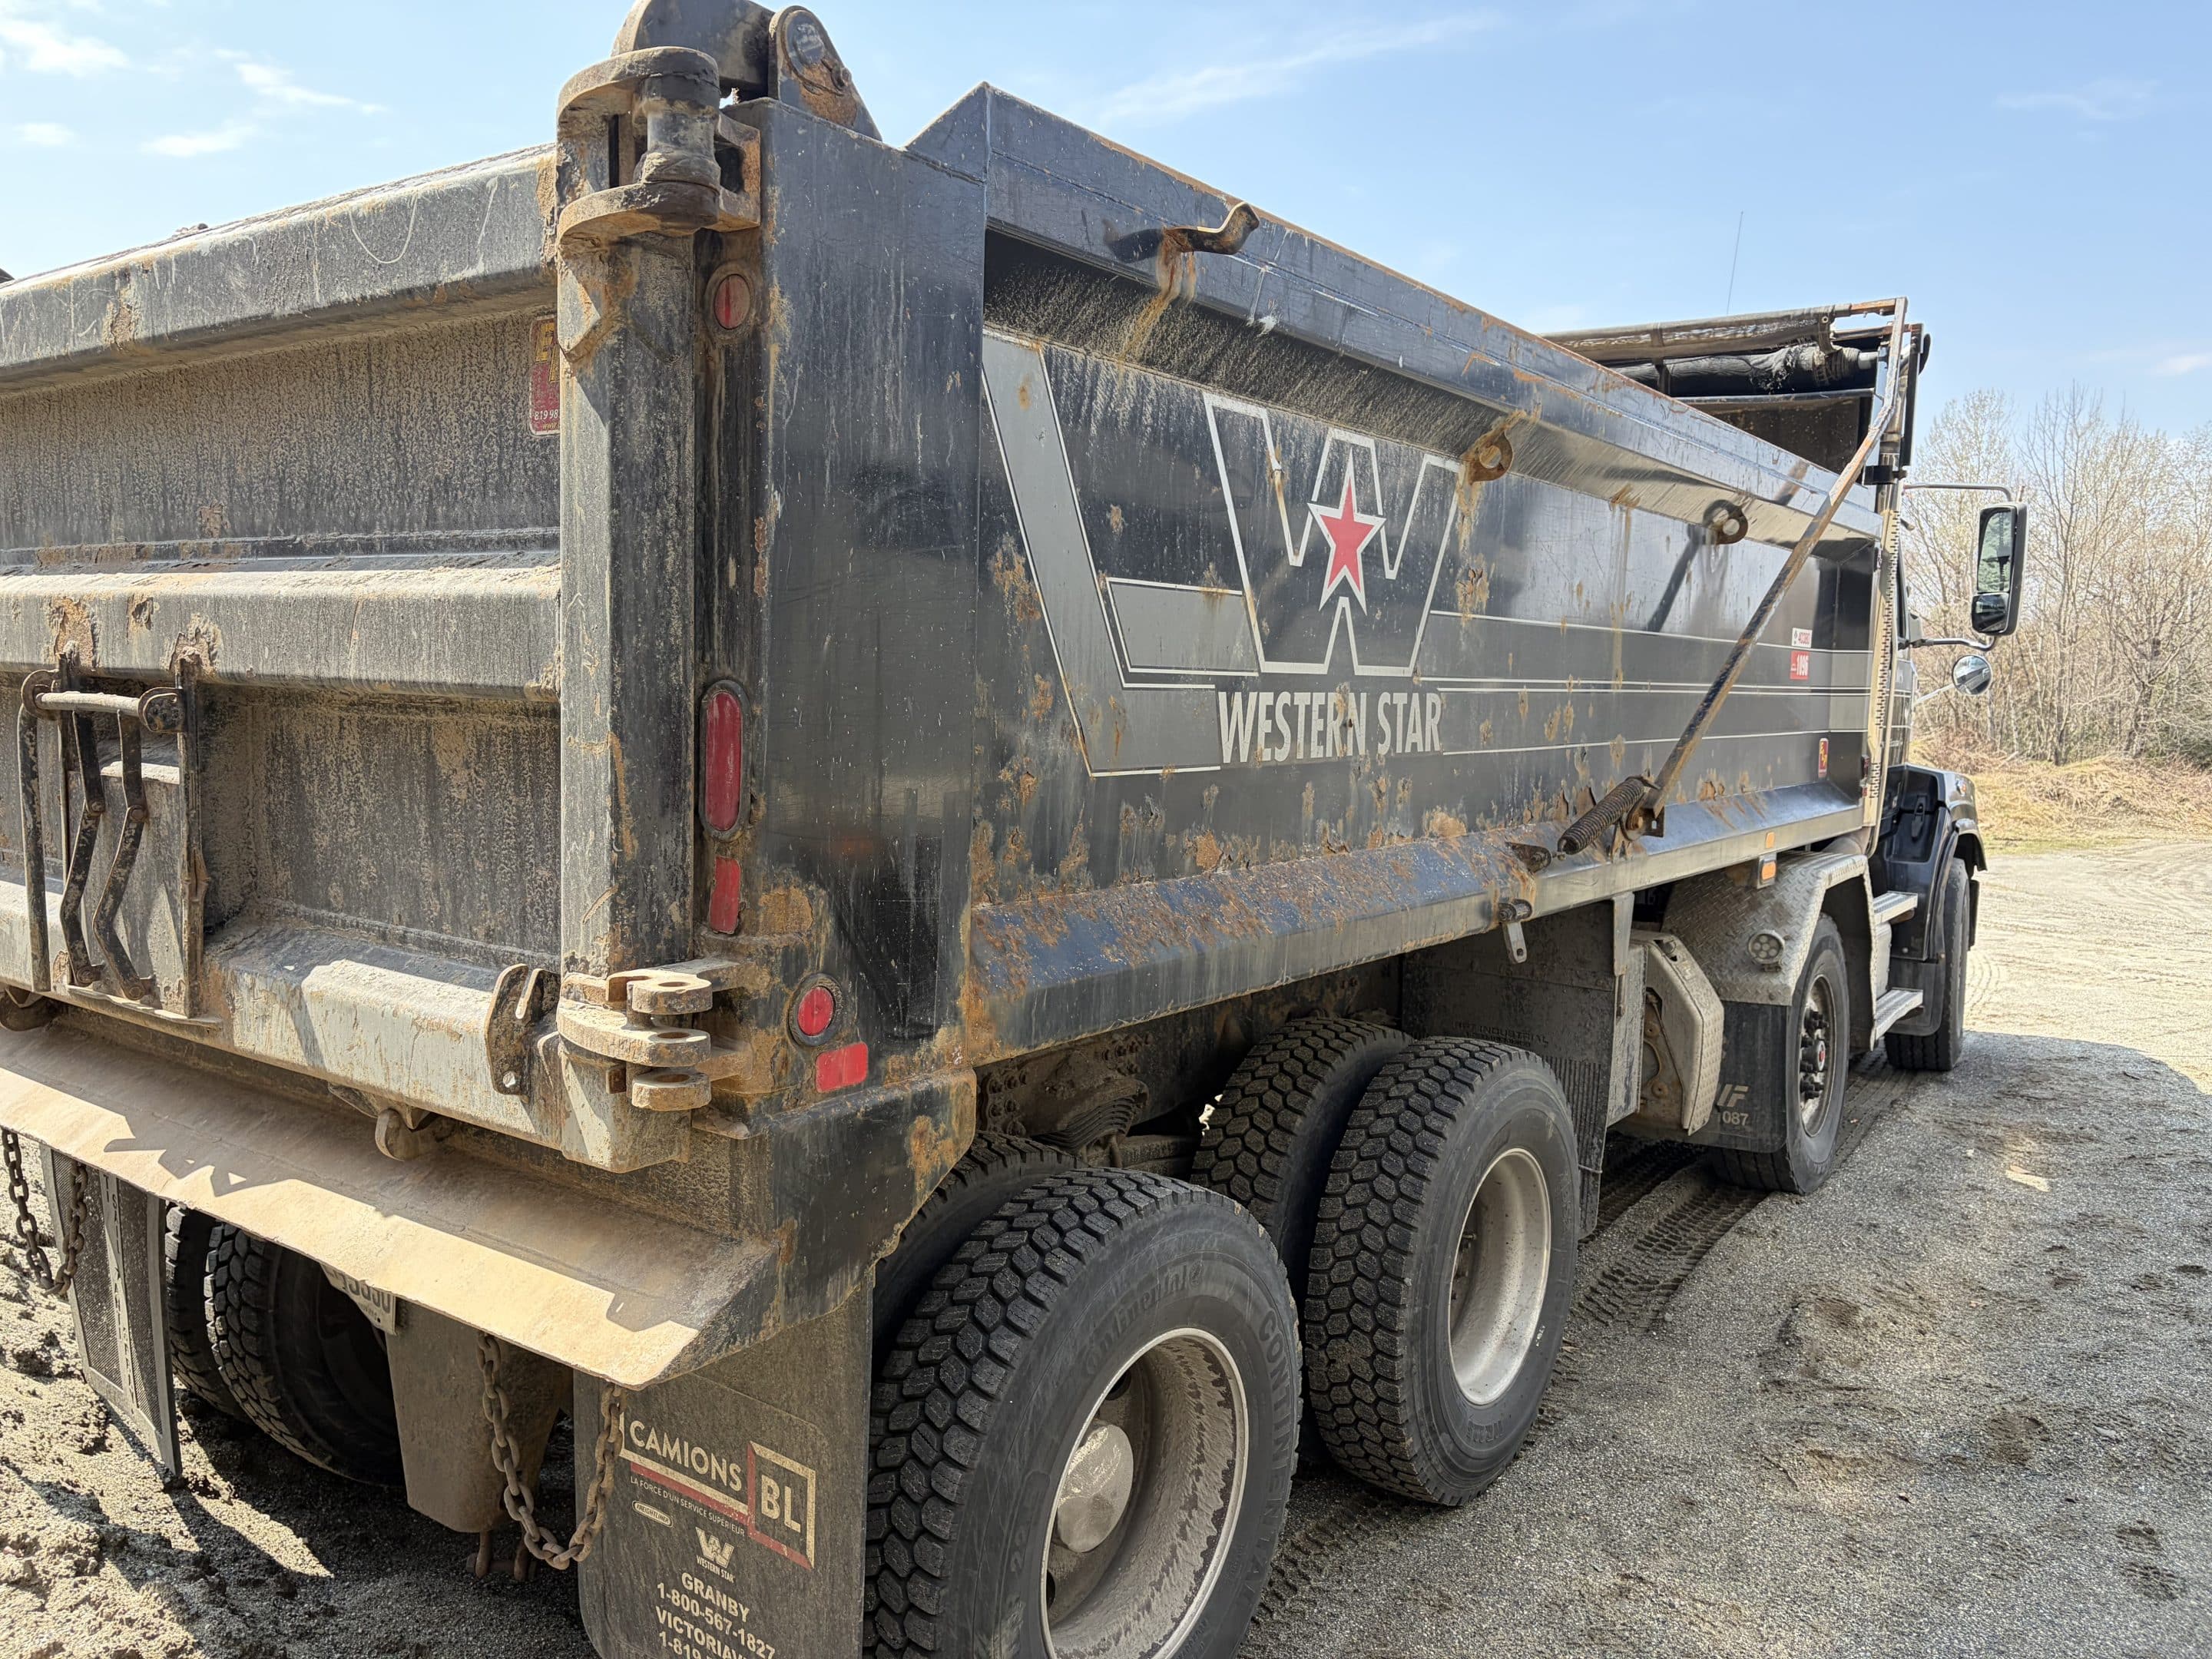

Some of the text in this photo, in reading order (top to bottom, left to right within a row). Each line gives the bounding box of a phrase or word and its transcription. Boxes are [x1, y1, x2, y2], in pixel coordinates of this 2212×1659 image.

[535, 409, 548, 421] 819
[1218, 691, 1442, 763] WESTERN STAR
[629, 1420, 743, 1492] CAMIONS
[631, 1475, 639, 1485] LA
[639, 1480, 662, 1495] FORCE
[663, 1489, 680, 1504] D'UN
[680, 1498, 707, 1518] SERVICE
[761, 1474, 801, 1533] BL
[696, 1555, 734, 1584] WESTERN STAR
[657, 1582, 776, 1659] 1-800-567-1827
[681, 1572, 750, 1623] GRANBY
[655, 1605, 747, 1659] VICTORIAV
